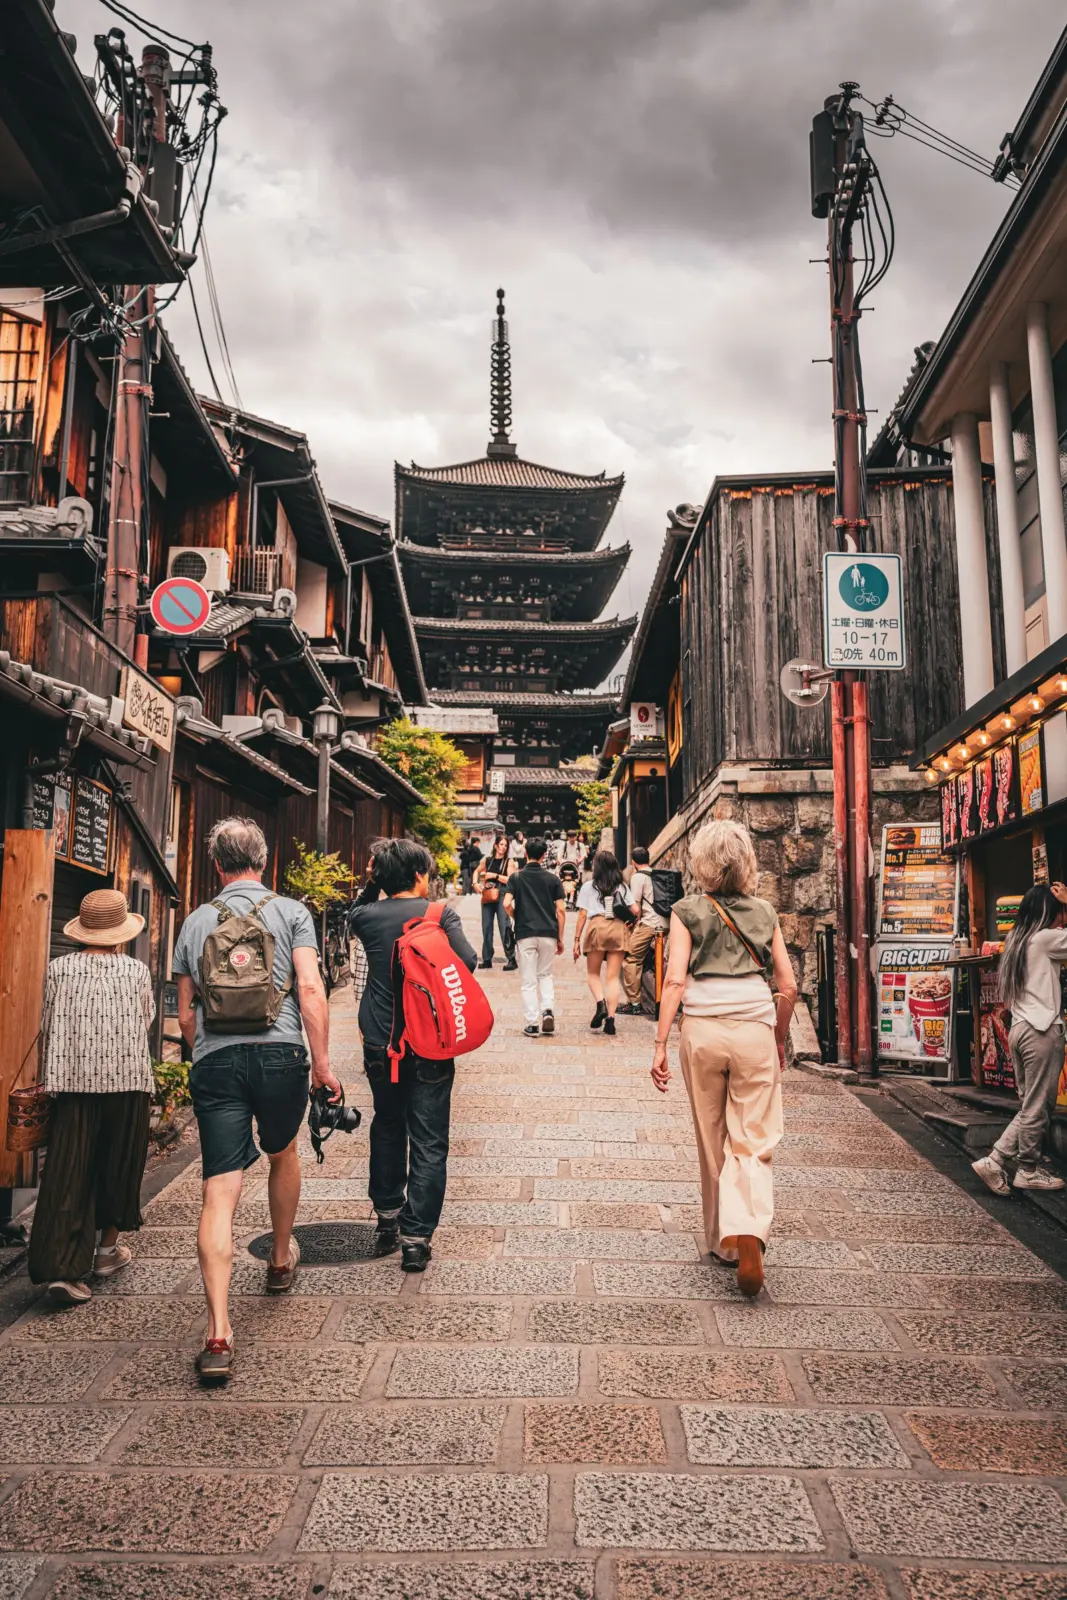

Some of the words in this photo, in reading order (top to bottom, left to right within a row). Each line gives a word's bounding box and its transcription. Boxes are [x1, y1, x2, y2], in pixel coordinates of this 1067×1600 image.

[831, 618, 898, 629] 土曜・日曜・休日
[869, 648, 898, 661] 40m
[886, 852, 904, 863] No.1
[934, 903, 953, 915] No.4
[882, 921, 901, 933] No.5
[441, 963, 467, 1045] Wilson
[923, 1020, 945, 1031] BIG
